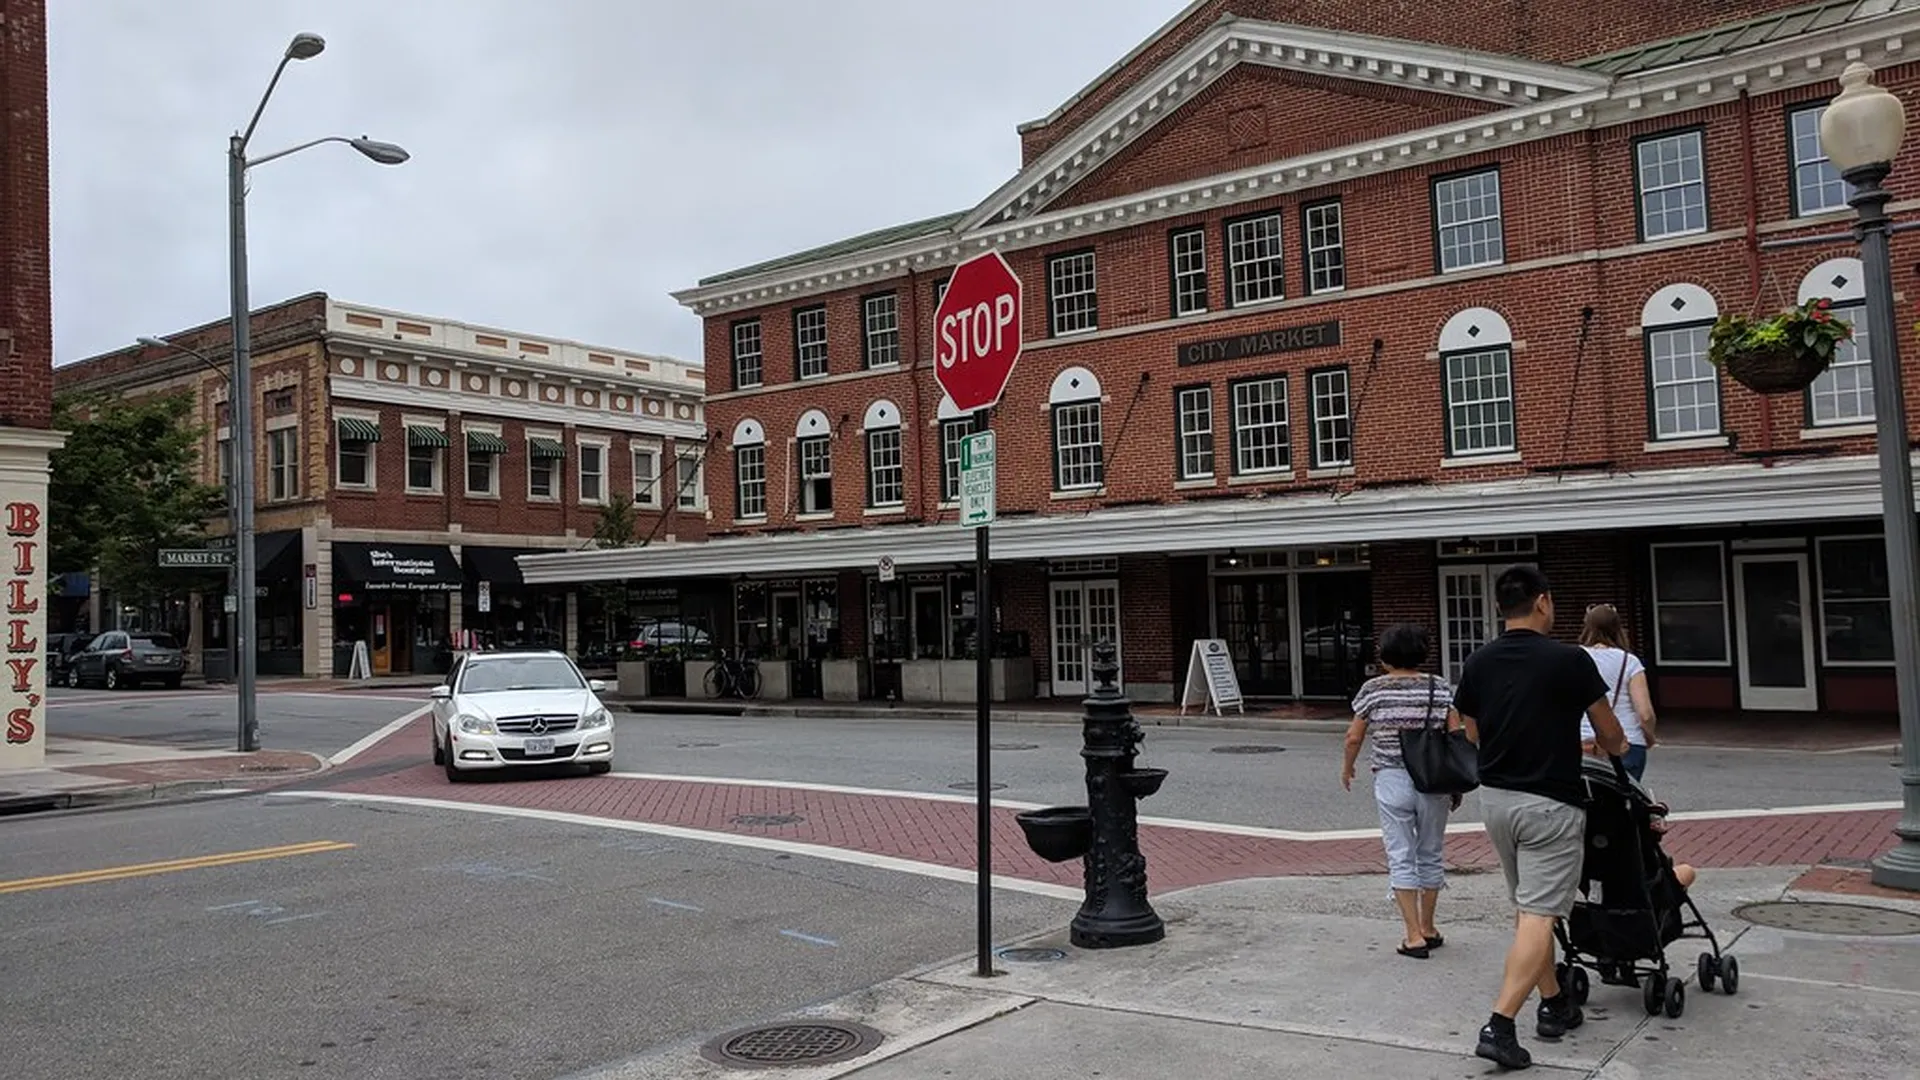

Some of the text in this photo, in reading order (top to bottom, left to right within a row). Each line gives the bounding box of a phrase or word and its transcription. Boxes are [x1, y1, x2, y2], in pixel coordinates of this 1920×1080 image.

[940, 293, 1015, 369] STOP
[1188, 326, 1326, 362] CITY MARKET
[973, 452, 993, 464] PARKING
[965, 468, 991, 485] ELECTRIC
[964, 481, 991, 496] VEHICLES
[970, 495, 985, 509] ONLY
[166, 552, 210, 563] MARKET
[211, 552, 223, 563] ST
[372, 559, 434, 568] International
[393, 567, 436, 576] Boutique
[5, 502, 40, 745] BILLY'S
